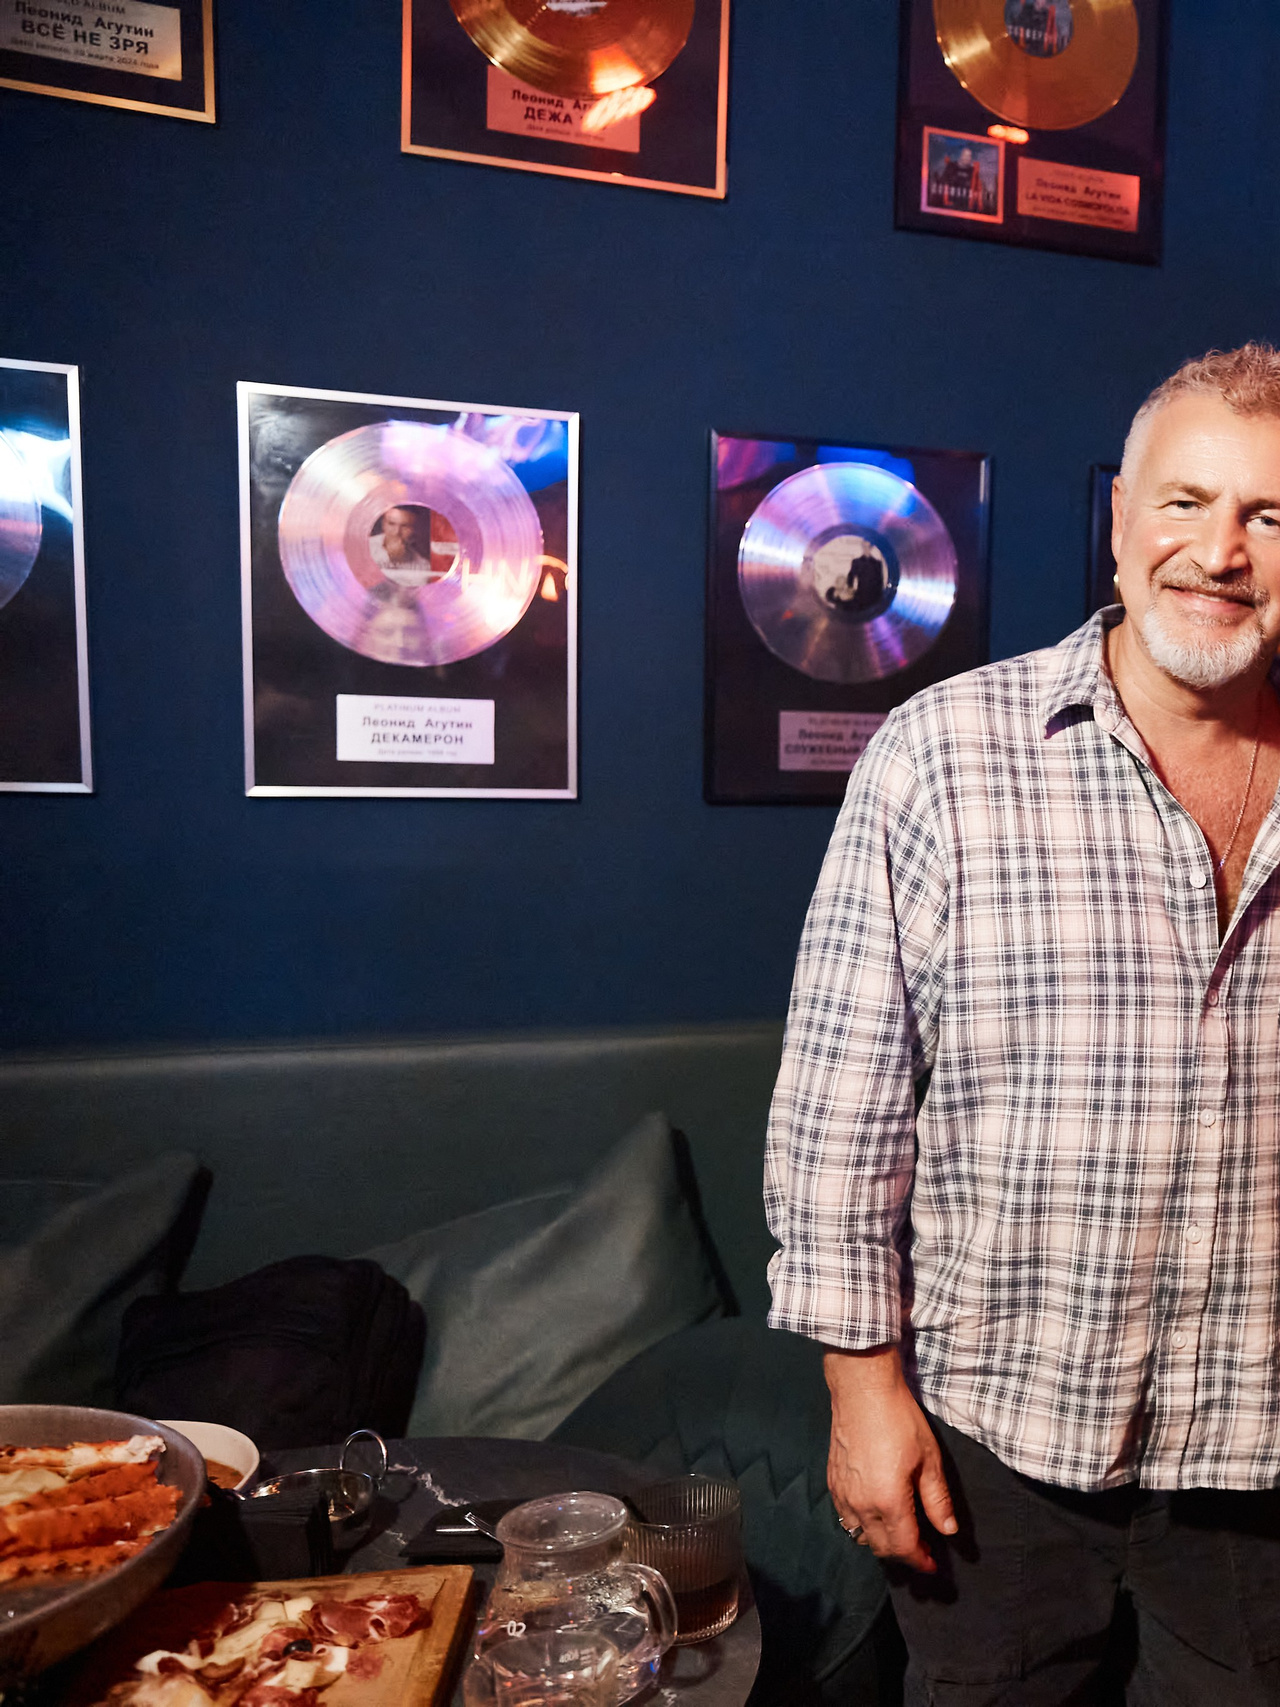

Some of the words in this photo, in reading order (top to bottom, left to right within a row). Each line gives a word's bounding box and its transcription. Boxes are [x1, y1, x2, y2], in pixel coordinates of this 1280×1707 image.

[95, 17, 154, 38] Агутин
[22, 20, 65, 40] ВСЁ
[74, 29, 101, 46] НЕ
[109, 36, 148, 55] ЗРЯ
[512, 89, 564, 109] Леонид
[524, 106, 573, 125] ДЕЖА
[362, 716, 415, 729] Леонид
[425, 718, 473, 731] Агутин
[371, 732, 464, 745] ДЕКАМЕРОН
